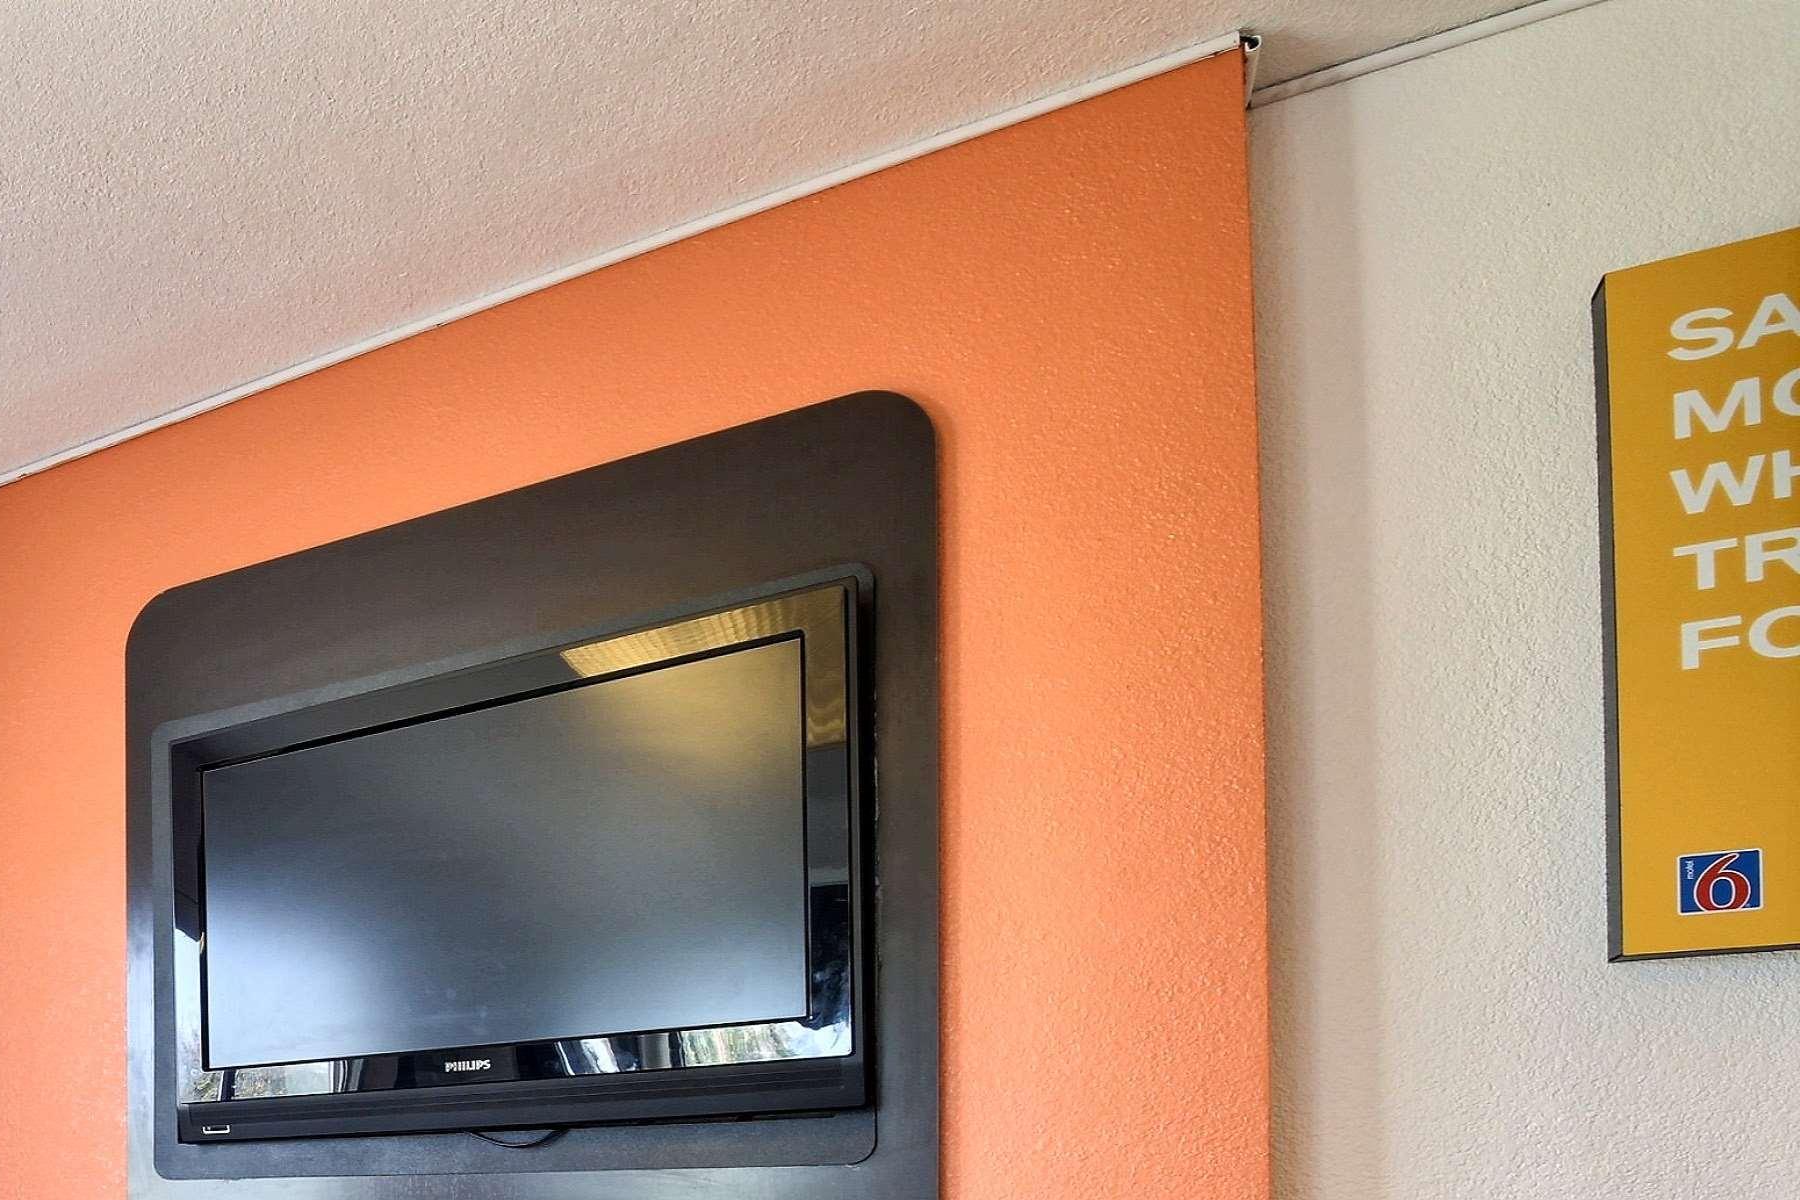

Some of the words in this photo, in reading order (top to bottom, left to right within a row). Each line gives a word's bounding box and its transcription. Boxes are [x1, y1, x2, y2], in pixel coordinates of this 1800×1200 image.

[1667, 292, 1800, 361] SA
[1672, 527, 1800, 591] TR
[1681, 605, 1800, 671] FO
[1693, 853, 1752, 912] 6
[444, 1059, 491, 1073] PHILIPS
